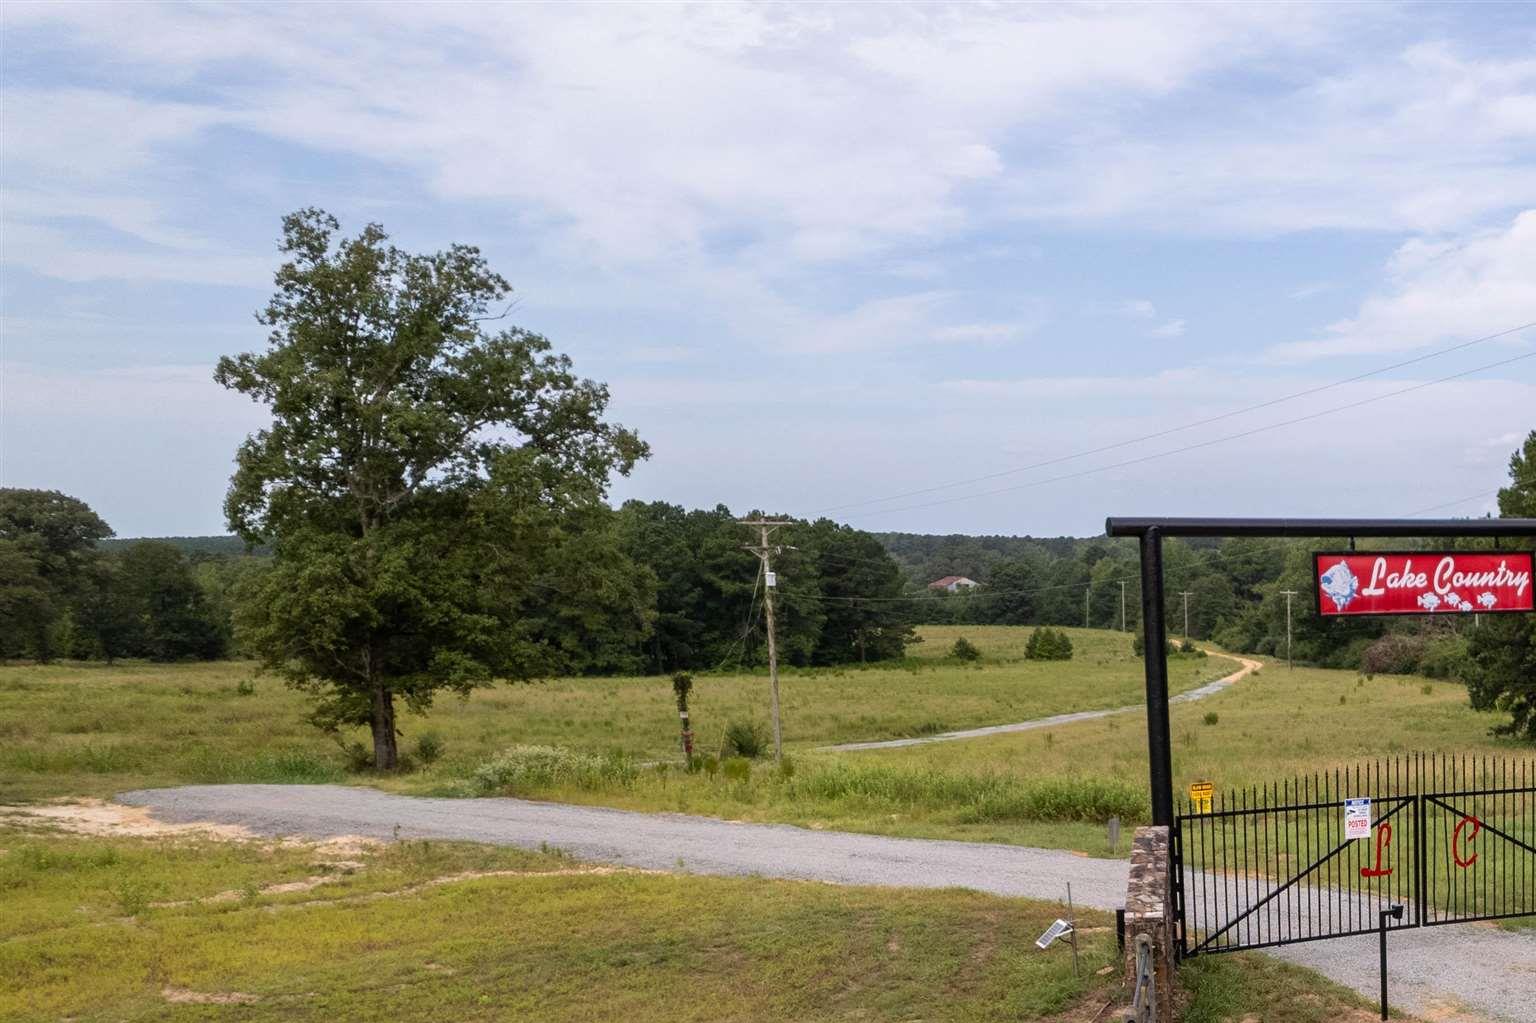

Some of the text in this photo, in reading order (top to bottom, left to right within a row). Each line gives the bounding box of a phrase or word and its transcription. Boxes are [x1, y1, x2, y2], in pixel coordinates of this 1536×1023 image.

[1362, 556, 1530, 597] Lake Country
[1453, 815, 1480, 868] C
